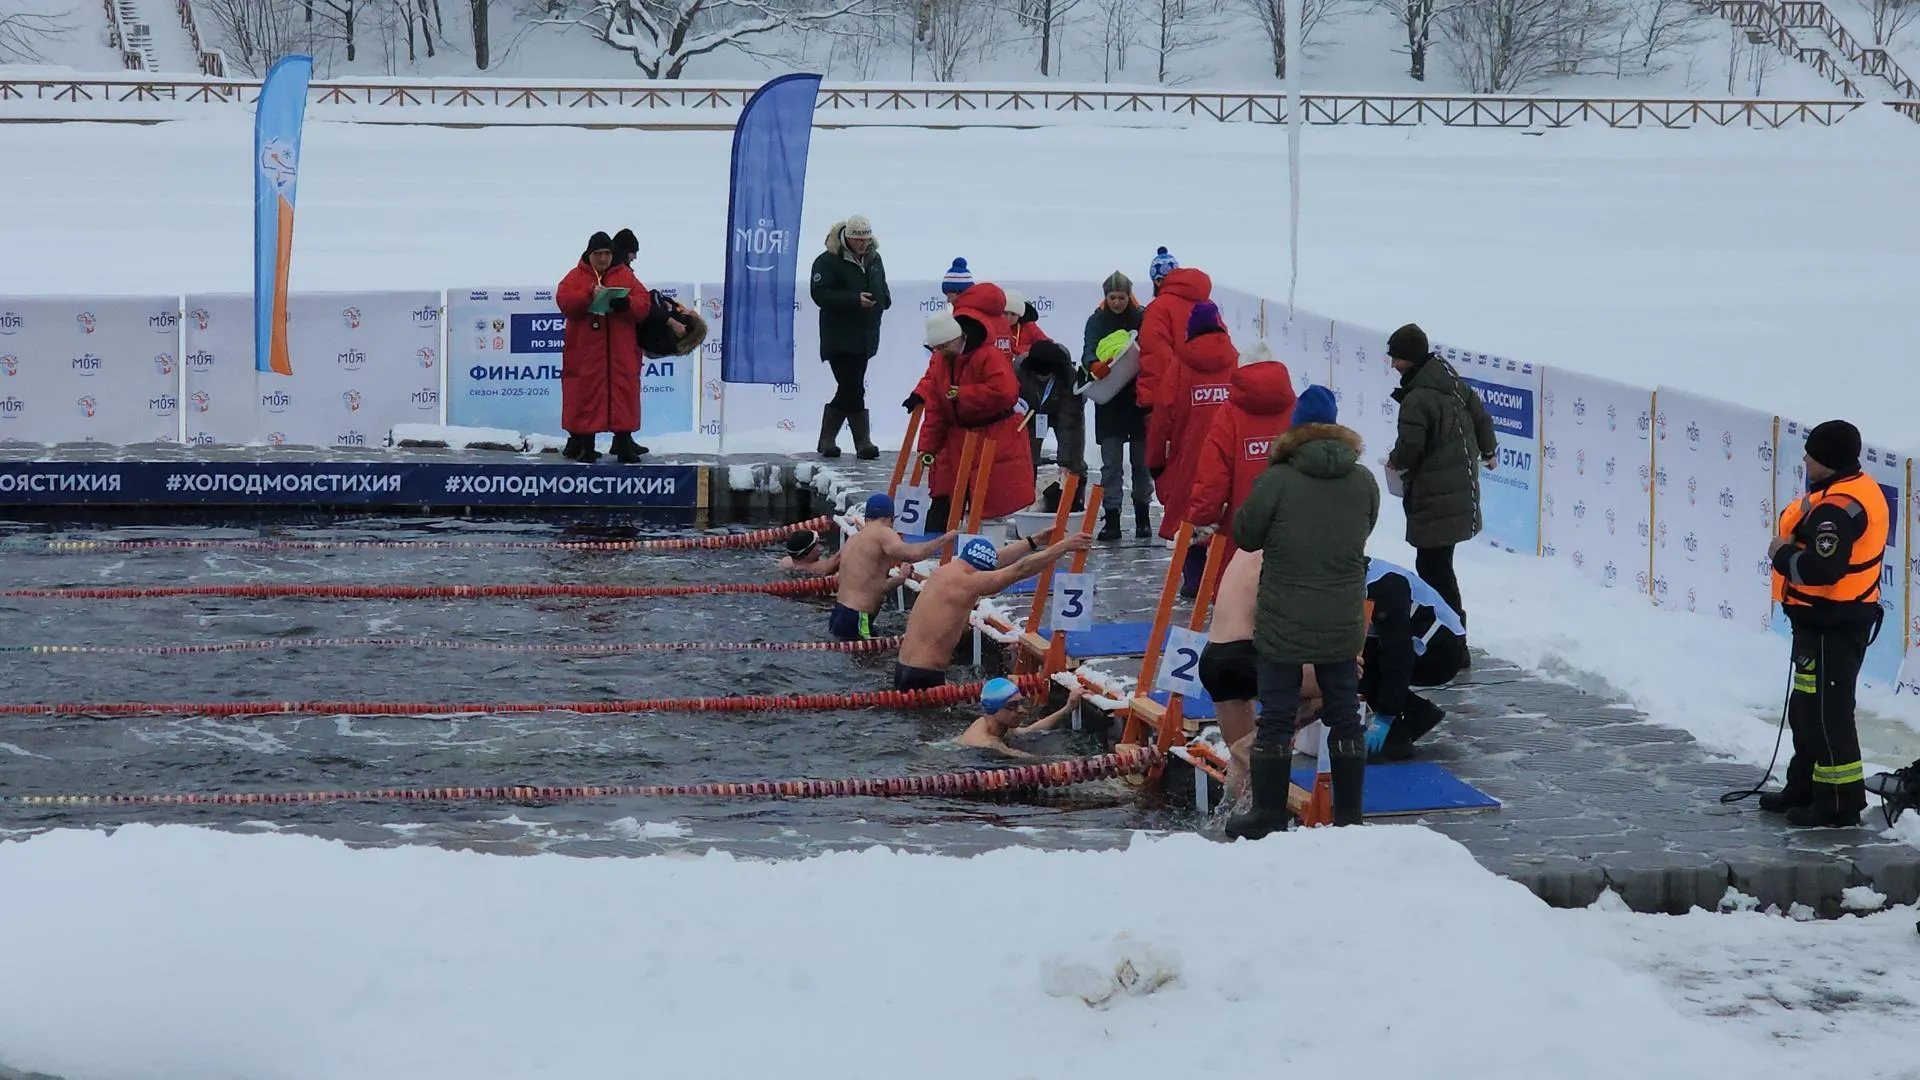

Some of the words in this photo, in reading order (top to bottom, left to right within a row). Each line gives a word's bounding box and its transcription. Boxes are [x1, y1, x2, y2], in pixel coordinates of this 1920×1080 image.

[469, 365, 563, 381] ФИНАЛЬ
[642, 362, 675, 377] АП
[469, 388, 498, 396] сезон
[501, 387, 550, 396] 2025-2026
[640, 385, 675, 393] бласть
[1194, 387, 1230, 401] СУДЬ
[1487, 389, 1523, 410] РОССИИ
[1503, 448, 1532, 471] ЭТАП
[166, 474, 401, 495] #ХОЛОДМОЯСТИХИЯ
[445, 475, 676, 496] #ХОЛОДМОЯСТИХИЯ
[900, 499, 920, 524] 5
[967, 548, 999, 567] WAVE
[973, 543, 997, 559] MAD
[1061, 588, 1084, 618] 3
[1171, 648, 1200, 682] 2
